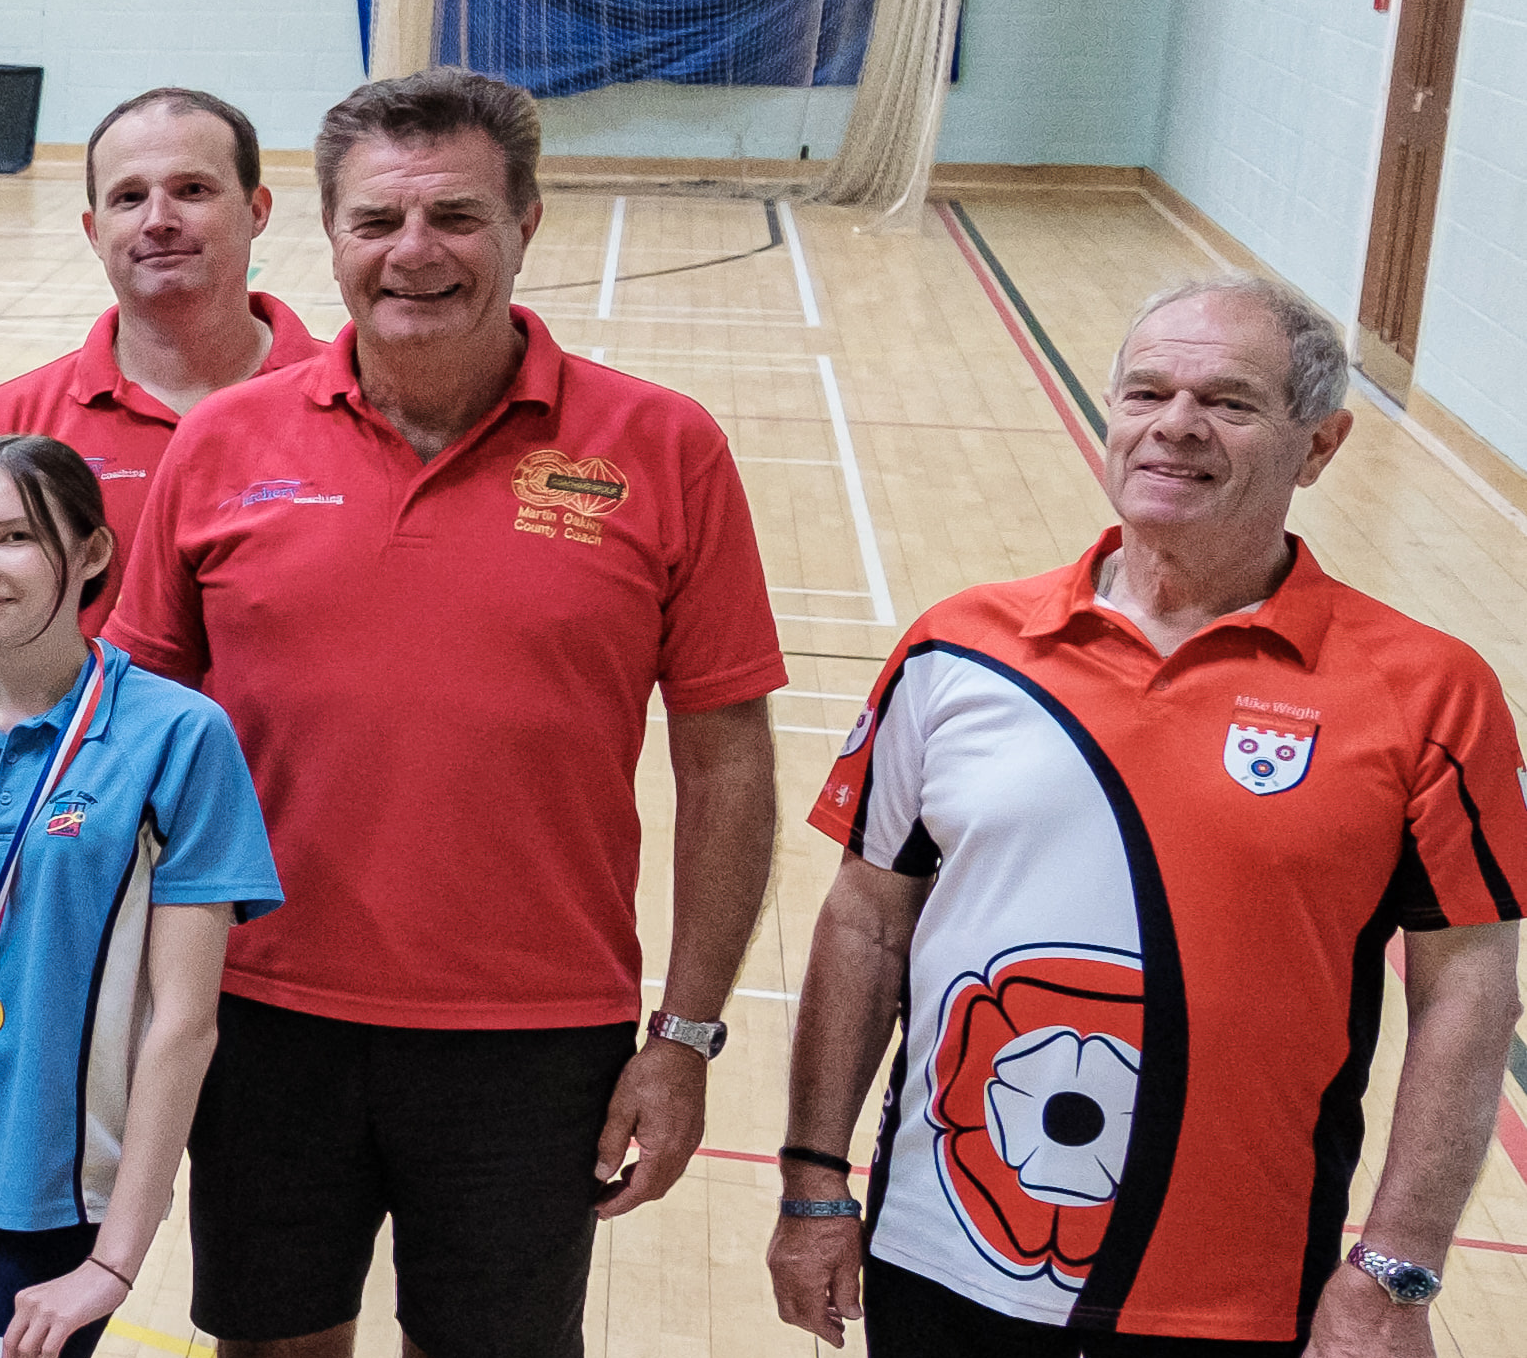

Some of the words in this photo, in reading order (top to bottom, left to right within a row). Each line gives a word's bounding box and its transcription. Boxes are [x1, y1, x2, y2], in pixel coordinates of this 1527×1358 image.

[241, 486, 297, 508] archery
[293, 493, 344, 505] coaching
[514, 518, 558, 539] County
[563, 527, 603, 547] Coach
[518, 505, 557, 522] Martin
[563, 512, 603, 536] Oakley
[1234, 694, 1271, 712] Mike
[1272, 701, 1323, 721] Wright
